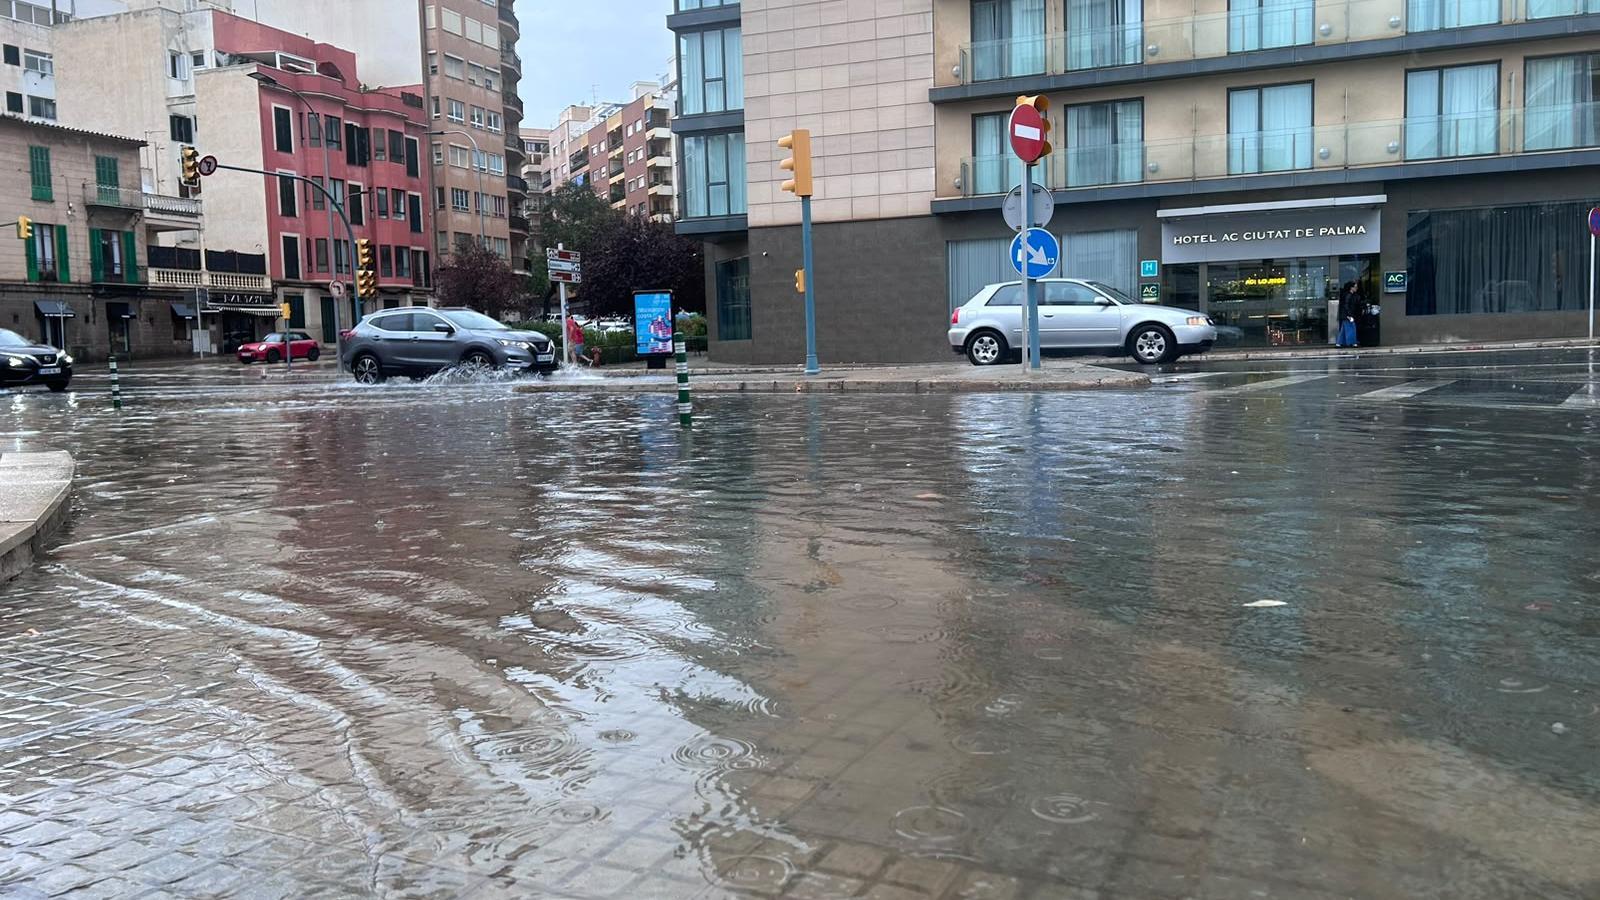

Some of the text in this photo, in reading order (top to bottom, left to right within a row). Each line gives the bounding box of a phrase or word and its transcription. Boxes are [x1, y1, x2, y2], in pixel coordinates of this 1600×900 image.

[1173, 225, 1367, 245] HOTEL AC CIUTAT DE PALMA
[1145, 263, 1153, 271] H
[1387, 274, 1404, 283] AC
